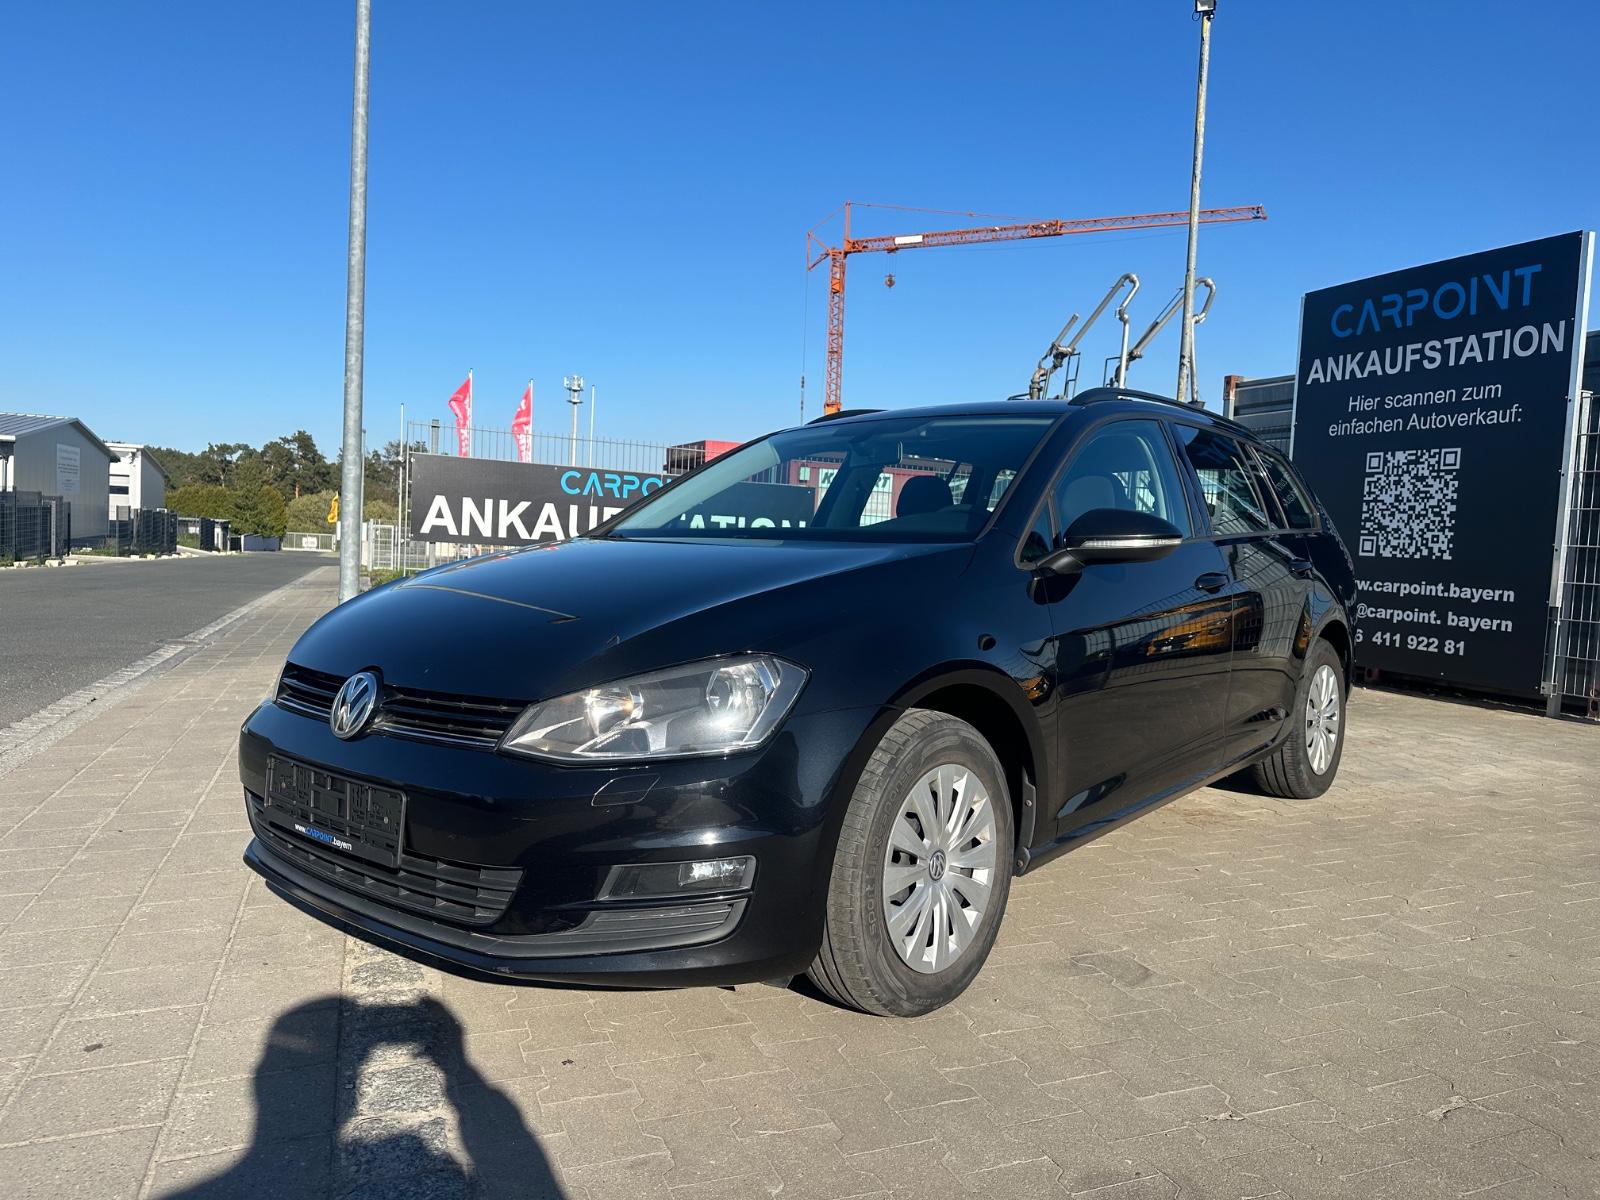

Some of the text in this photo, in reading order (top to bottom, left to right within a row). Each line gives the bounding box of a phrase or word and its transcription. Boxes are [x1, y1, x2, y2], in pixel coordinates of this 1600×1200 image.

[1330, 263, 1543, 338] CARPOINT
[1306, 320, 1566, 385] ANKAUFSTATION
[1348, 383, 1502, 413] Hier scannen zum
[1328, 403, 1523, 437] einfachen Autoverkauf:
[560, 470, 673, 499] CARPO
[1354, 579, 1515, 603] w.carpoint.bayern
[1447, 611, 1513, 633] bayern
[1372, 631, 1401, 648] 411
[1407, 634, 1439, 653] 922
[1444, 639, 1465, 656] 81
